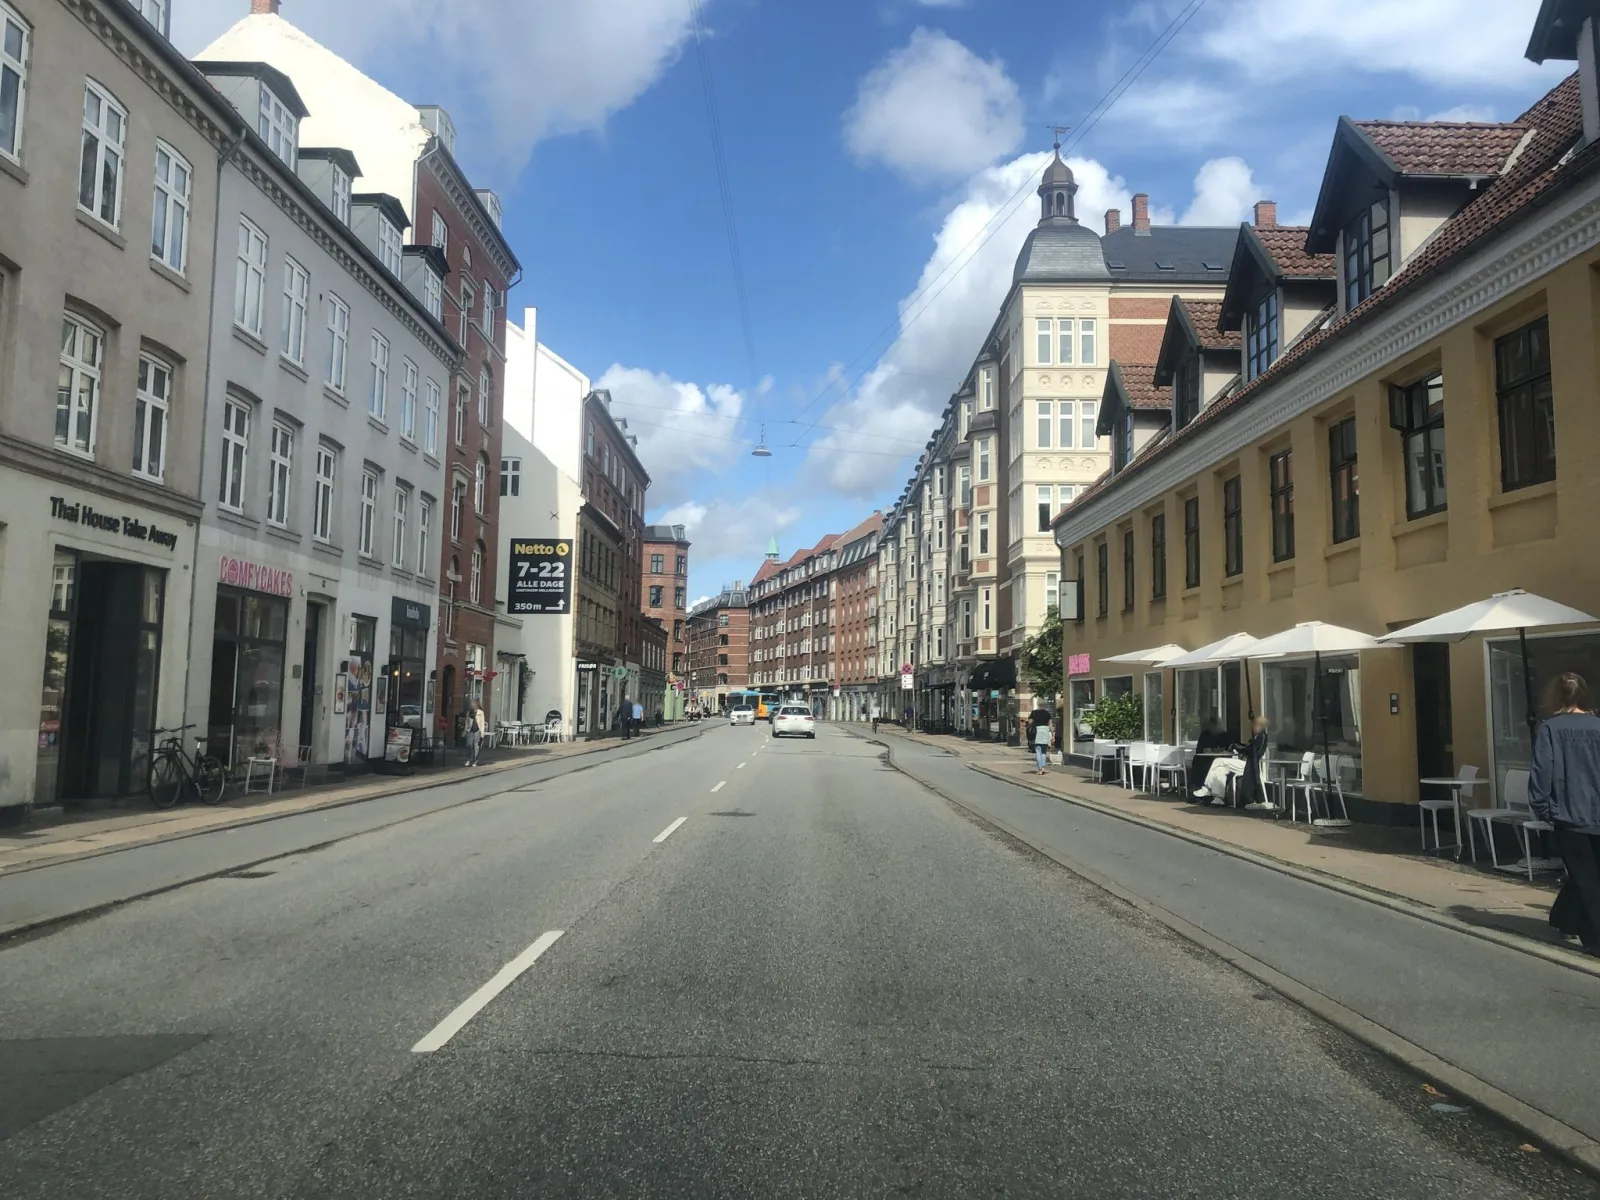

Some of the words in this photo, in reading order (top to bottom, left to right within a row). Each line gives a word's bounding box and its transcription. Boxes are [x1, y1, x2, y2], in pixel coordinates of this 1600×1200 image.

[50, 496, 80, 523] Thai
[81, 505, 120, 533] House
[122, 516, 148, 540] Take
[148, 525, 178, 552] Away
[515, 543, 554, 555] Netto
[517, 561, 565, 578] 7-22
[516, 580, 538, 588] ALLE
[540, 580, 565, 588] DAGE
